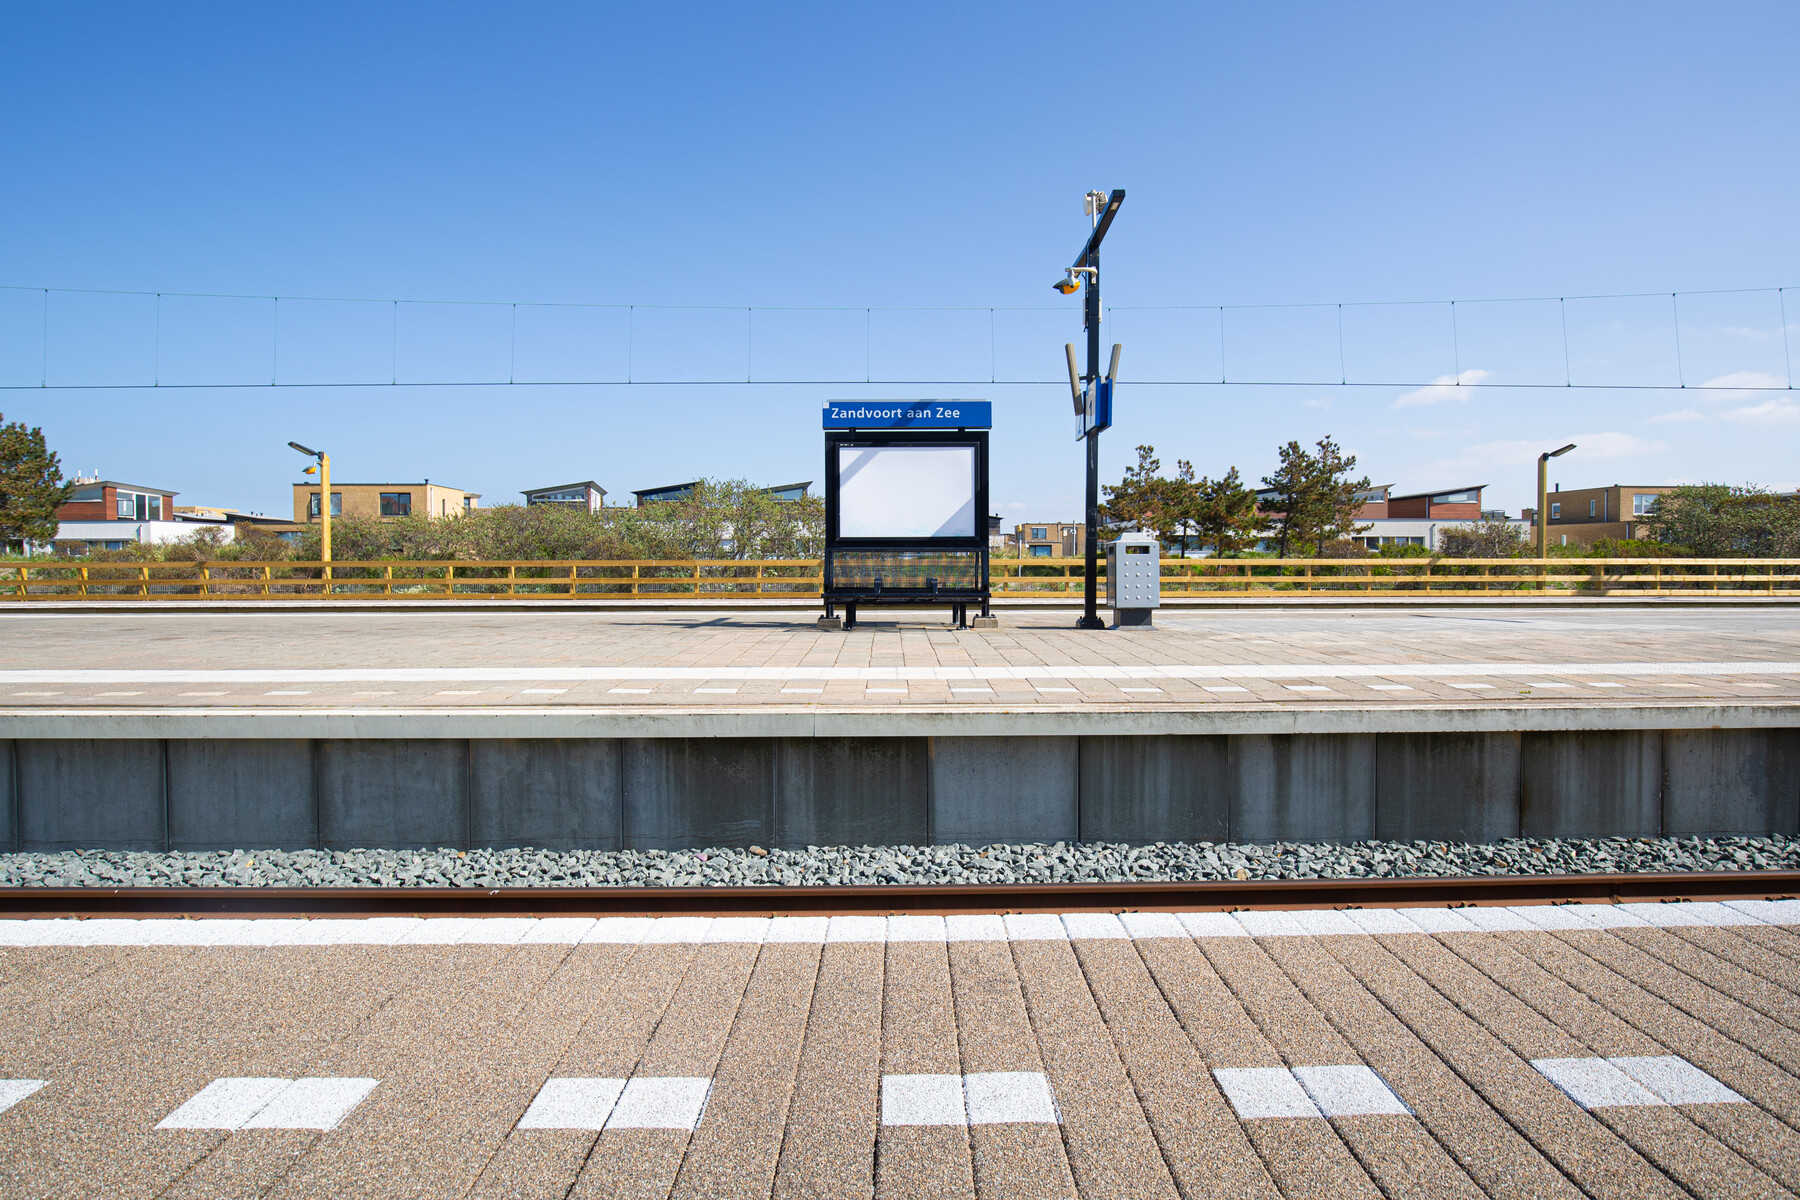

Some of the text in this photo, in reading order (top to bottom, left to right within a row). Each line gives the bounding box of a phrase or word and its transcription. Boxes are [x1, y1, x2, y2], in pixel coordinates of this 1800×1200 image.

[831, 407, 961, 418] Zandvoort aan Zee
